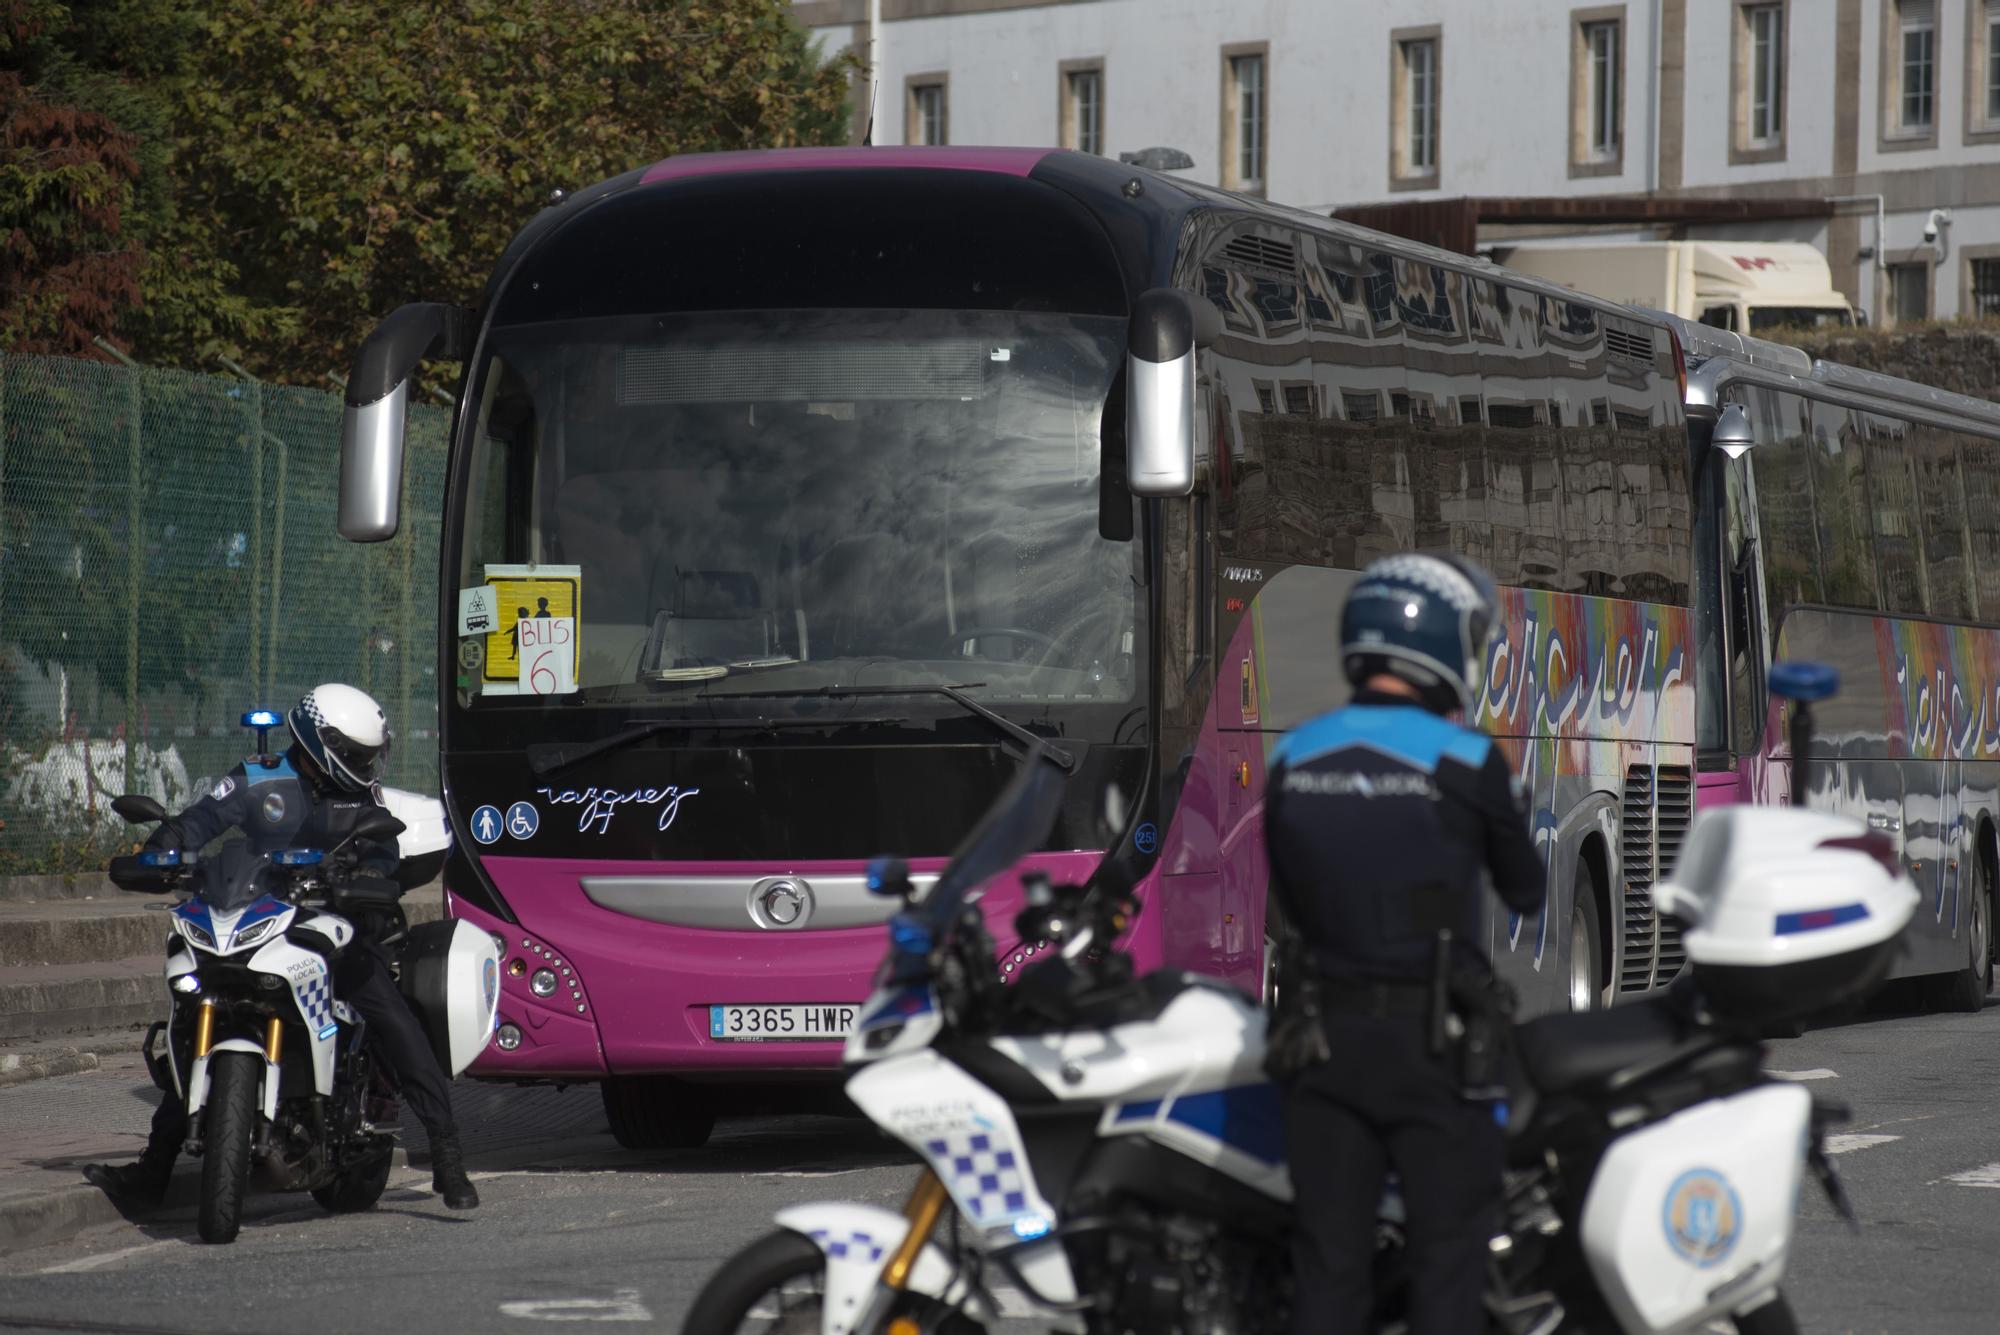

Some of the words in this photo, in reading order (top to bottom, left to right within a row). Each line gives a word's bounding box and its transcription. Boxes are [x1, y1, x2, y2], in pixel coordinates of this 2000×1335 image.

[521, 620, 570, 647] BUS
[530, 650, 557, 695] 6
[293, 966, 317, 981] LOCAL
[730, 1008, 795, 1032] 3365
[805, 1008, 855, 1032] HWR
